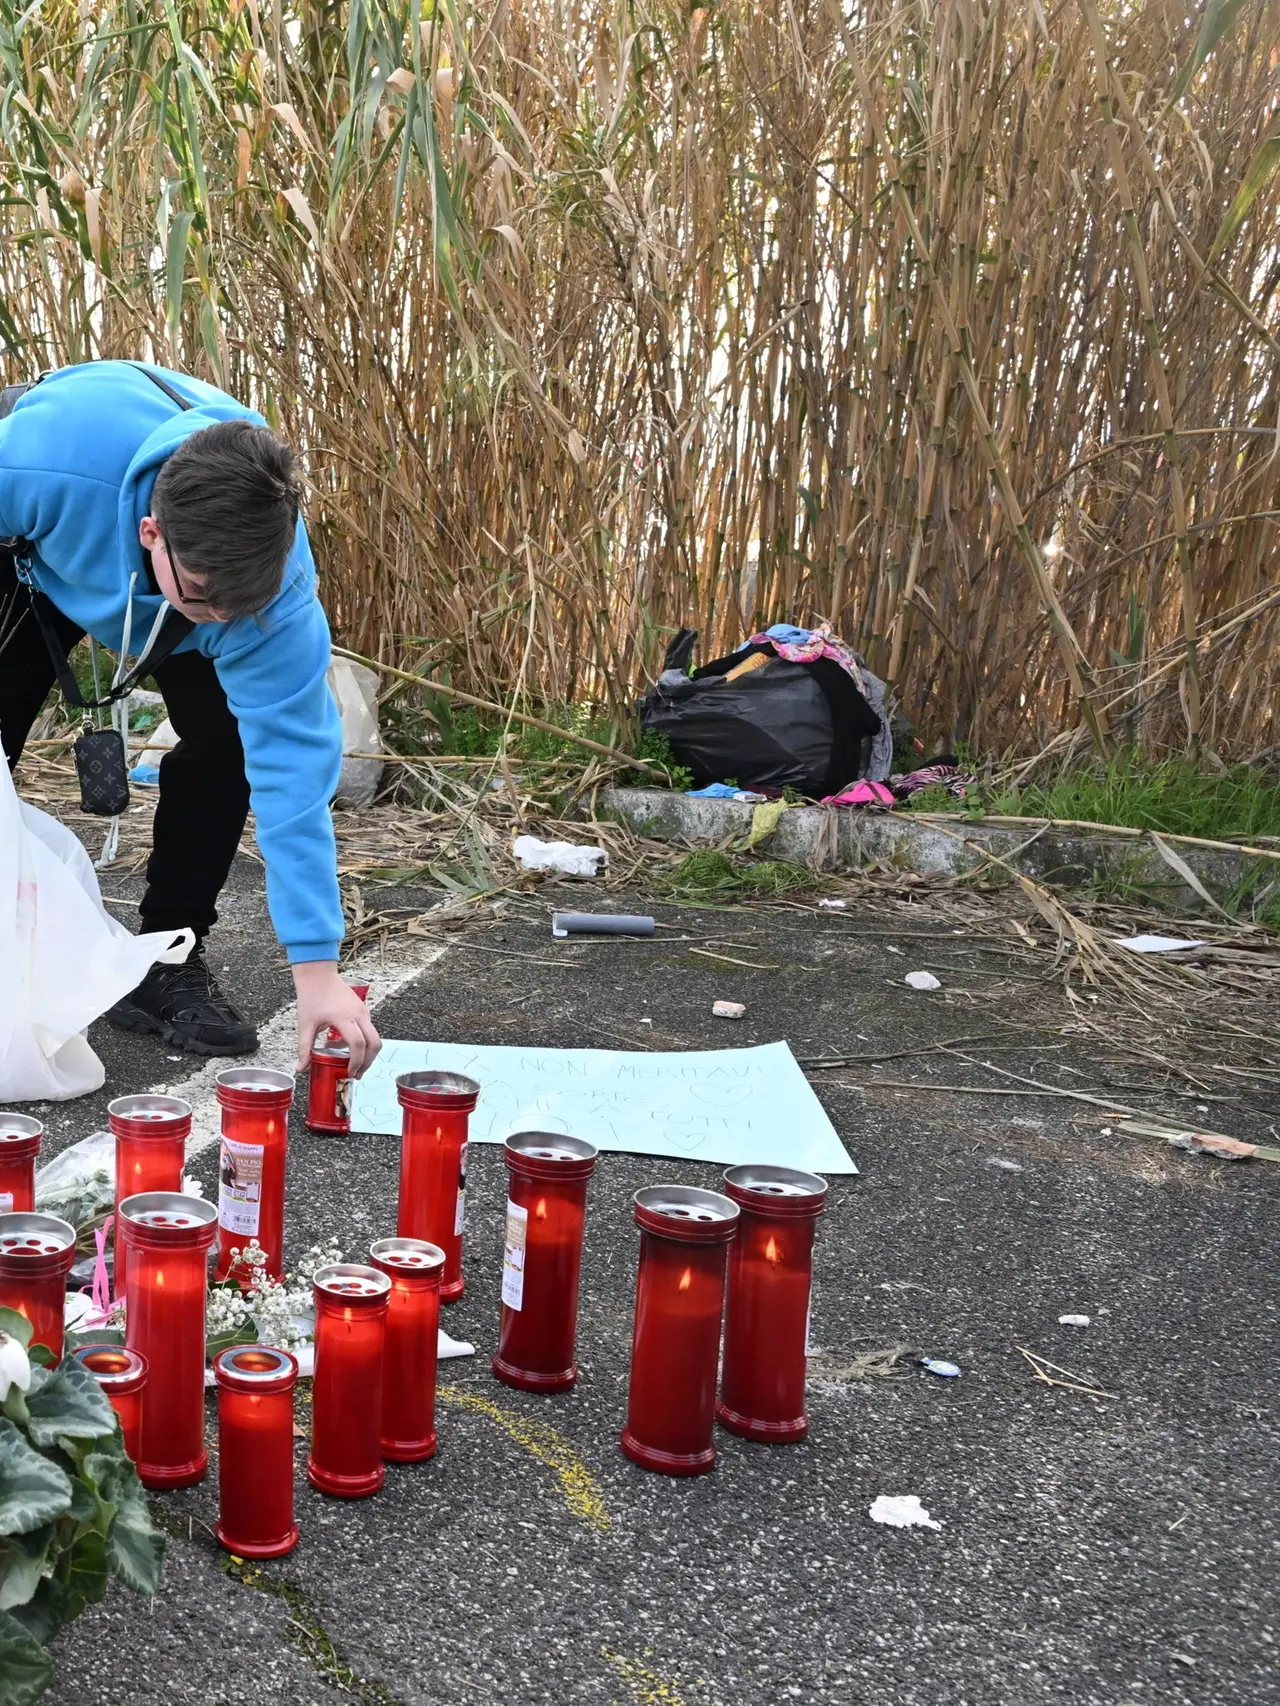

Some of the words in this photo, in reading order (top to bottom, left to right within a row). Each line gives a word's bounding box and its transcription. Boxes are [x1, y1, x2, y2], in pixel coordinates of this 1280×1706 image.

[377, 1047, 491, 1073] LEX
[520, 1056, 588, 1077] NON
[617, 1063, 763, 1080] MERITAVI
[648, 1109, 753, 1130] TUTTI
